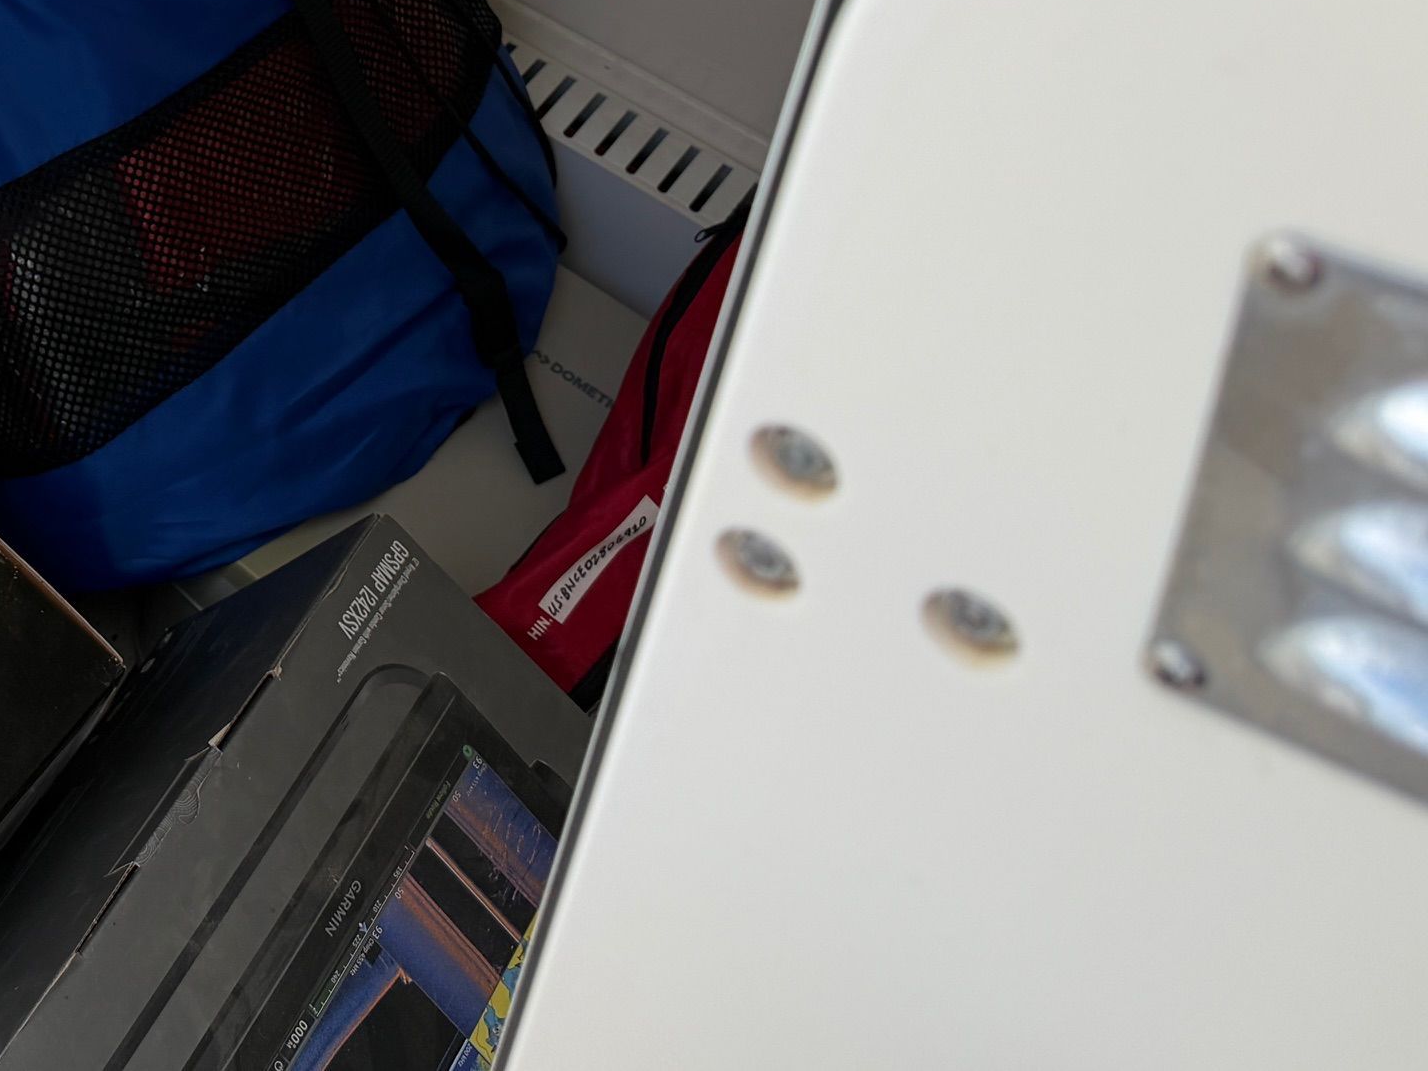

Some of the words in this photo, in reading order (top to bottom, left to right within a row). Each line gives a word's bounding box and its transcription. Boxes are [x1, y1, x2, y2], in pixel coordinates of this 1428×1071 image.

[550, 362, 614, 409] DOMETI
[371, 539, 409, 593] GPSMAP
[338, 584, 379, 641] 1242XSV
[473, 755, 483, 769] 93
[452, 790, 461, 802] 50
[393, 866, 402, 878] 195
[394, 887, 404, 899] 50
[325, 880, 361, 937] GARMIN
[373, 899, 382, 913] 210
[372, 925, 383, 940] 93
[352, 934, 361, 948] 225
[331, 970, 340, 984] 240
